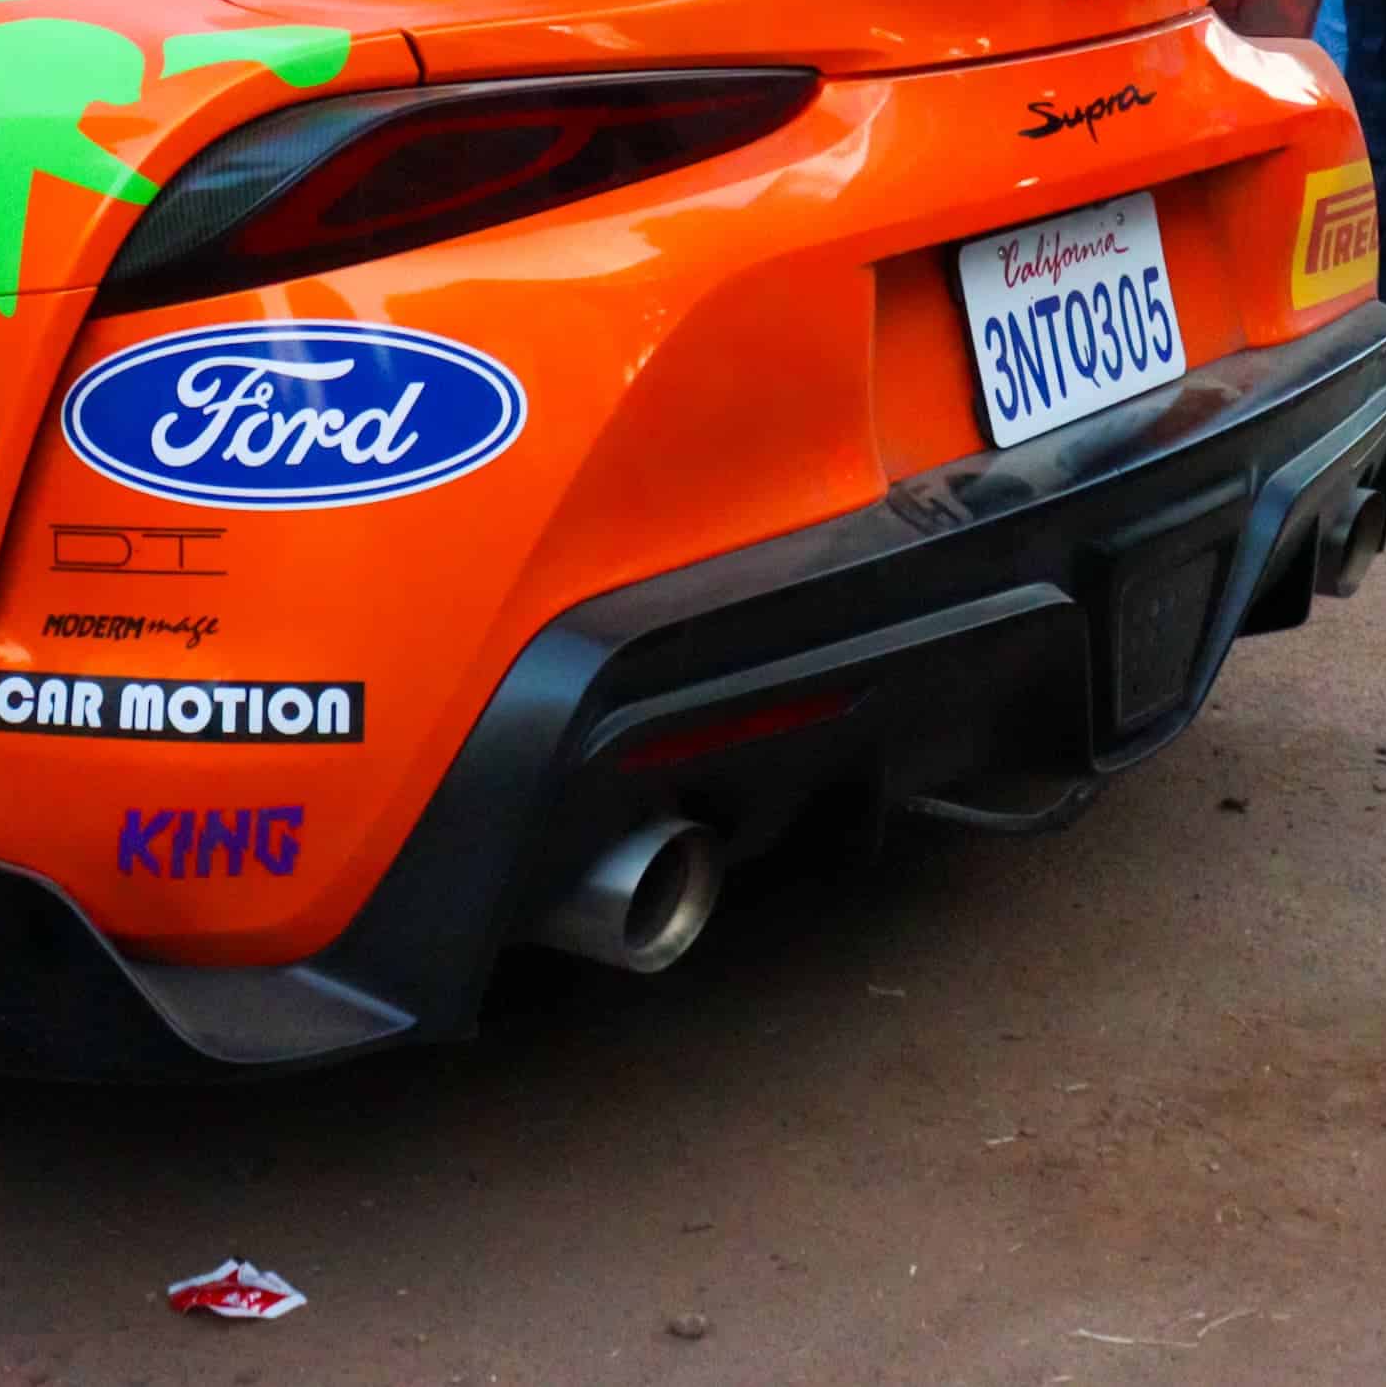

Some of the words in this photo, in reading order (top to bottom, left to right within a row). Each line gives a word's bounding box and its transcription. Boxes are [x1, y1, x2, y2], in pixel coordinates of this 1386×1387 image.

[1018, 84, 1158, 143] Supra
[1001, 226, 1130, 289] California
[984, 266, 1173, 422] 3NTQ305
[150, 356, 425, 467] Ford
[119, 683, 350, 735] MOTION
[118, 805, 304, 879] KING
